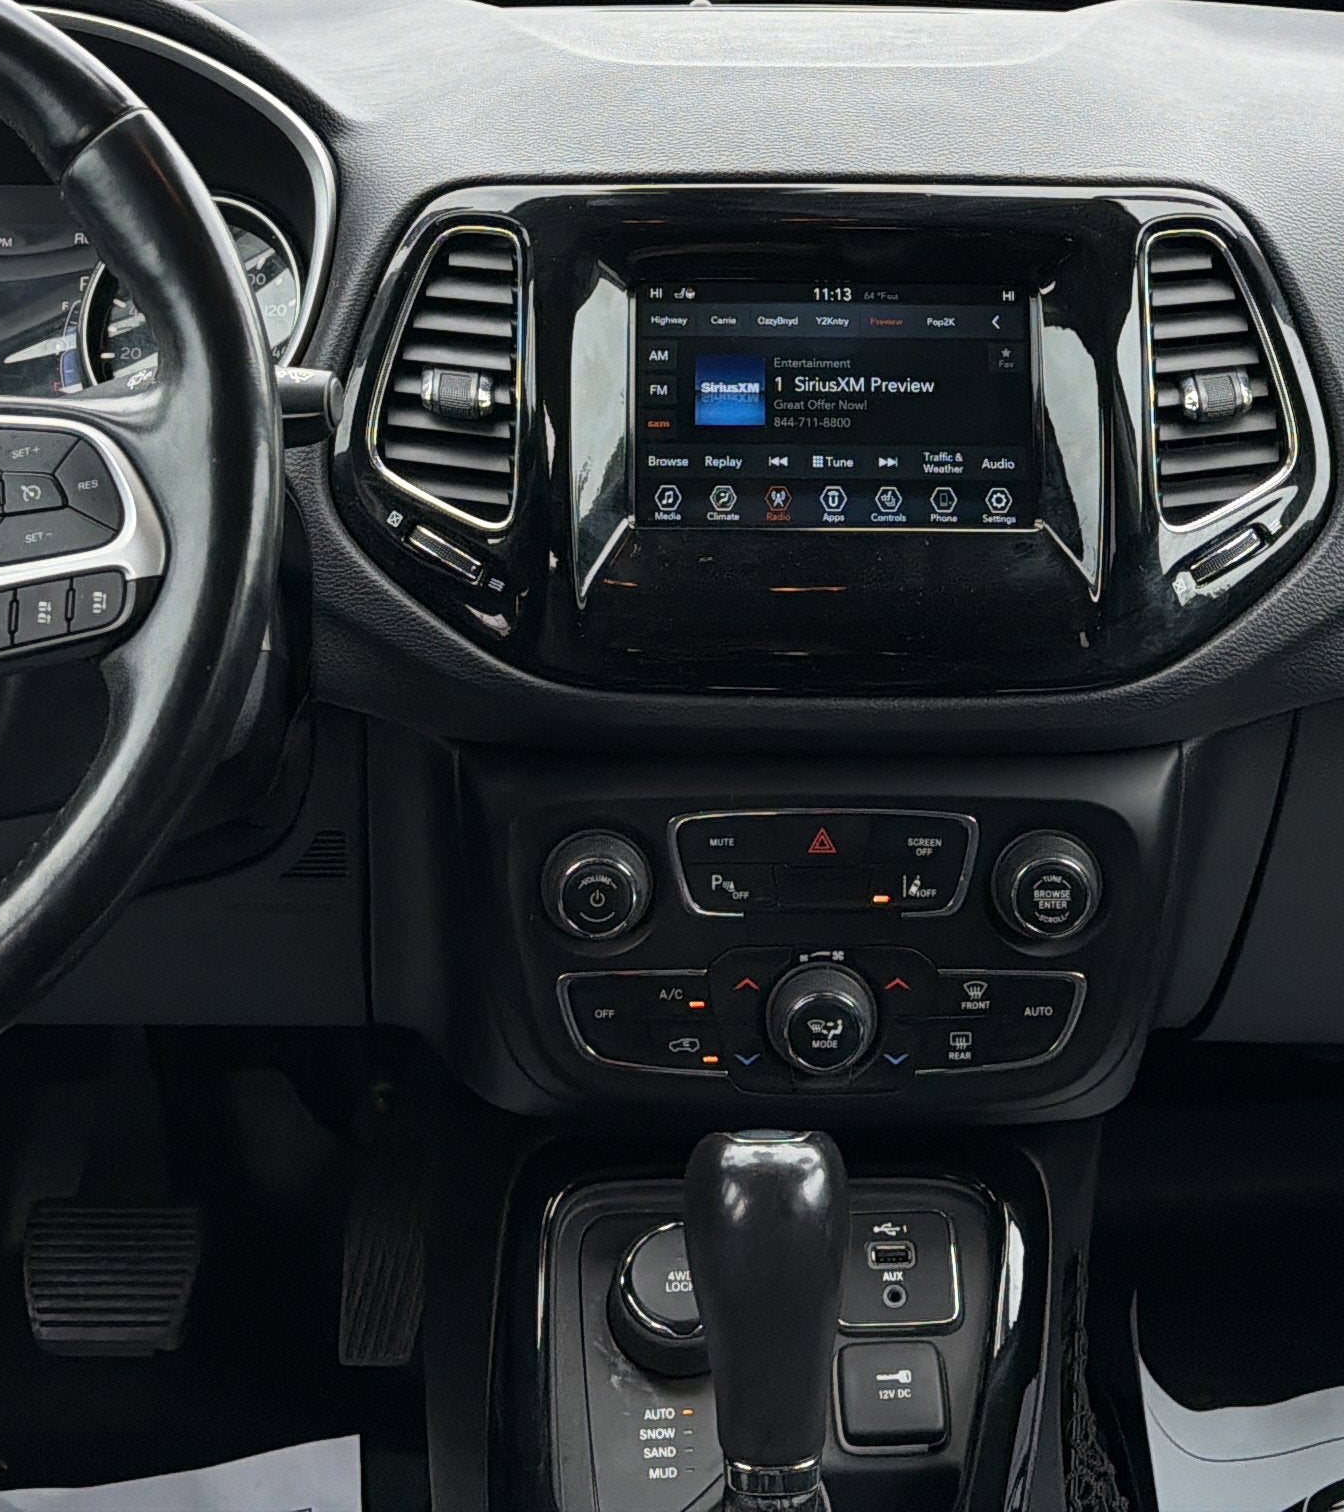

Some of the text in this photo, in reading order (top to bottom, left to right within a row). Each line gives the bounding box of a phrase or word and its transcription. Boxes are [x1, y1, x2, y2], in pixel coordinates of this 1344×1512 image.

[650, 288, 662, 299] HI
[814, 288, 852, 301] 11:13
[1002, 290, 1015, 301] HI
[650, 316, 688, 326] Highway
[926, 317, 956, 327] Pop2K
[120, 347, 142, 360] 20
[648, 350, 669, 361] AM
[774, 357, 851, 369] Entertainment
[998, 360, 1014, 369] Fav
[649, 385, 668, 396] FM
[700, 382, 760, 394] SiriusXM
[774, 377, 935, 393] 1 SiriusXM Preview
[773, 400, 868, 410] Great Offer Now!
[773, 417, 851, 428] 844-711-8800
[12, 447, 32, 460] SET
[923, 452, 963, 462] Traffic &
[648, 456, 689, 467] Browse
[705, 456, 742, 469] Replay
[826, 456, 854, 468] Tune
[982, 458, 1015, 470] Audio
[923, 464, 964, 474] Weather
[77, 479, 99, 491] RES
[655, 512, 682, 521] Media
[707, 512, 740, 521] Climate
[766, 512, 791, 521] Radio
[822, 513, 845, 523] Apps
[871, 513, 906, 522] Controls
[930, 514, 957, 522] Phone
[982, 514, 1016, 524] Settings
[24, 532, 44, 544] SET
[709, 838, 735, 847] MUTE
[907, 838, 942, 847] SCREEN
[916, 848, 933, 856] OFF
[581, 875, 612, 885] VOLUME
[1043, 875, 1063, 884] TUNE
[732, 891, 750, 900] OFF
[920, 888, 937, 898] OFF
[1033, 889, 1071, 898] BROWSE
[1038, 901, 1068, 910] ENTER
[1039, 914, 1067, 924] SCROLL
[659, 988, 684, 1002] A/C
[961, 1000, 991, 1011] FRONT
[594, 1007, 616, 1020] OFF
[1024, 1006, 1054, 1018] AUTO
[812, 1039, 839, 1050] MODE
[948, 1050, 972, 1061] REAR
[883, 1271, 904, 1282] AUX
[878, 1389, 912, 1400] 12V DC
[643, 1408, 676, 1421] AUTO
[639, 1428, 676, 1440] SNOW
[643, 1446, 677, 1459] SAND
[649, 1466, 678, 1479] MUD
